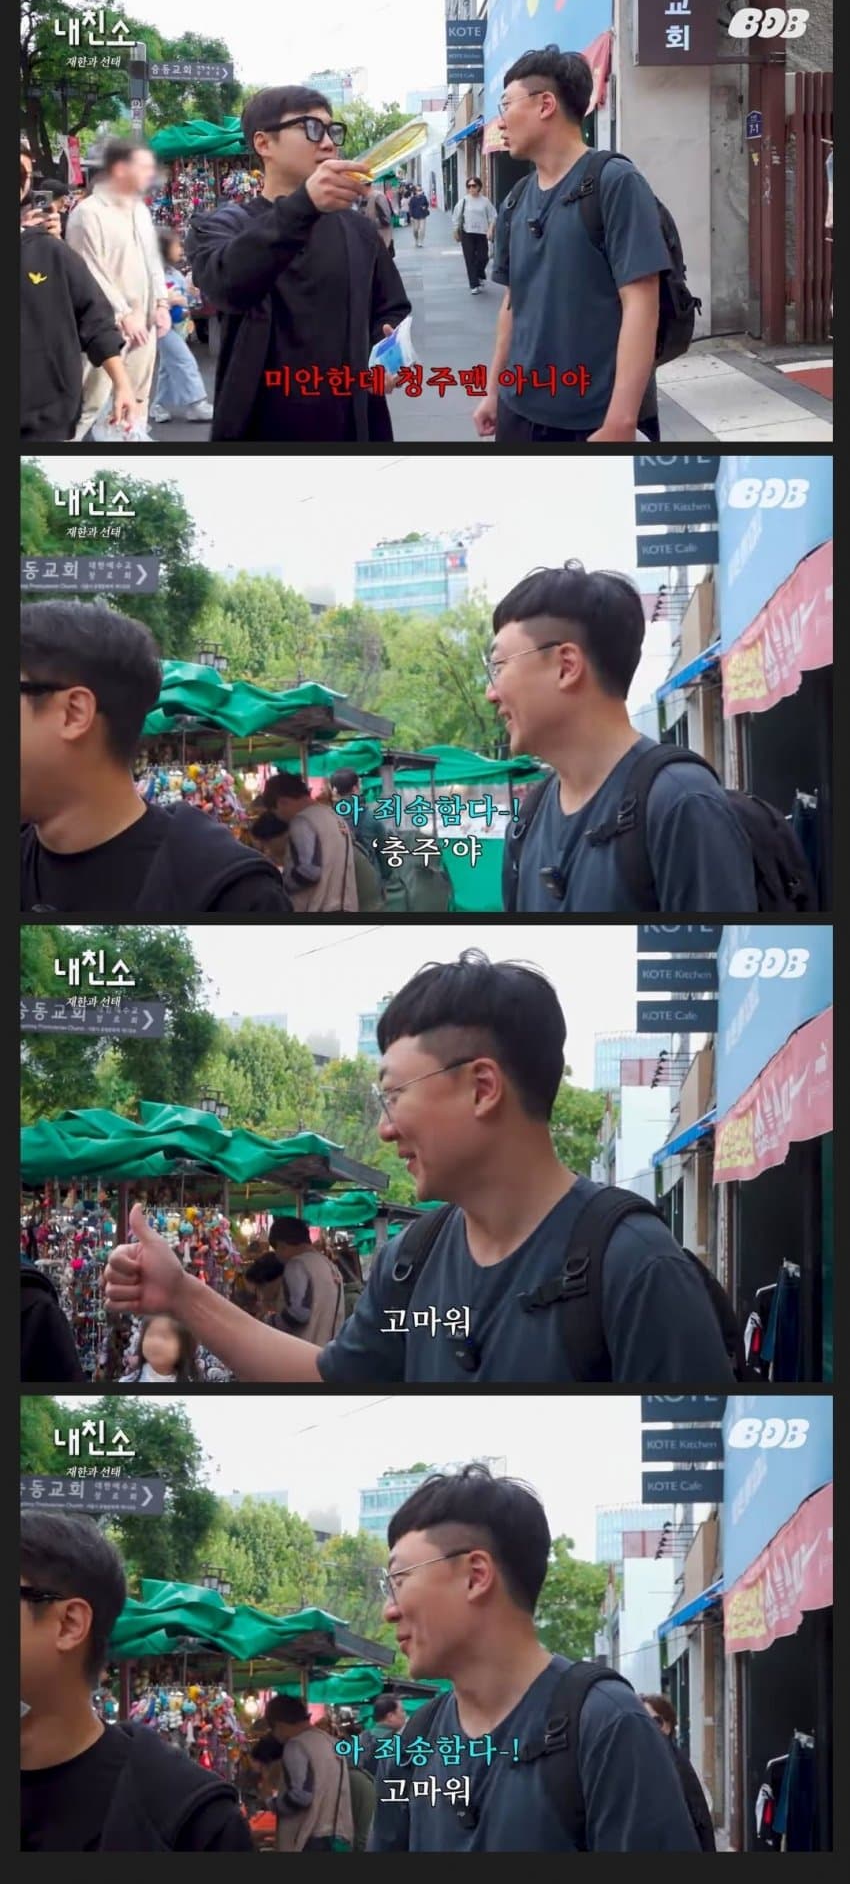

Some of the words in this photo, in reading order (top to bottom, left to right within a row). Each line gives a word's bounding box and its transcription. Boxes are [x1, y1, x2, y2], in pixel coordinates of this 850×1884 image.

[448, 26, 482, 37] KOTE
[642, 970, 672, 979] KOTE
[642, 1011, 672, 1021] KOTE
[646, 1440, 677, 1450] KOTE
[647, 1482, 678, 1491] KOTE
